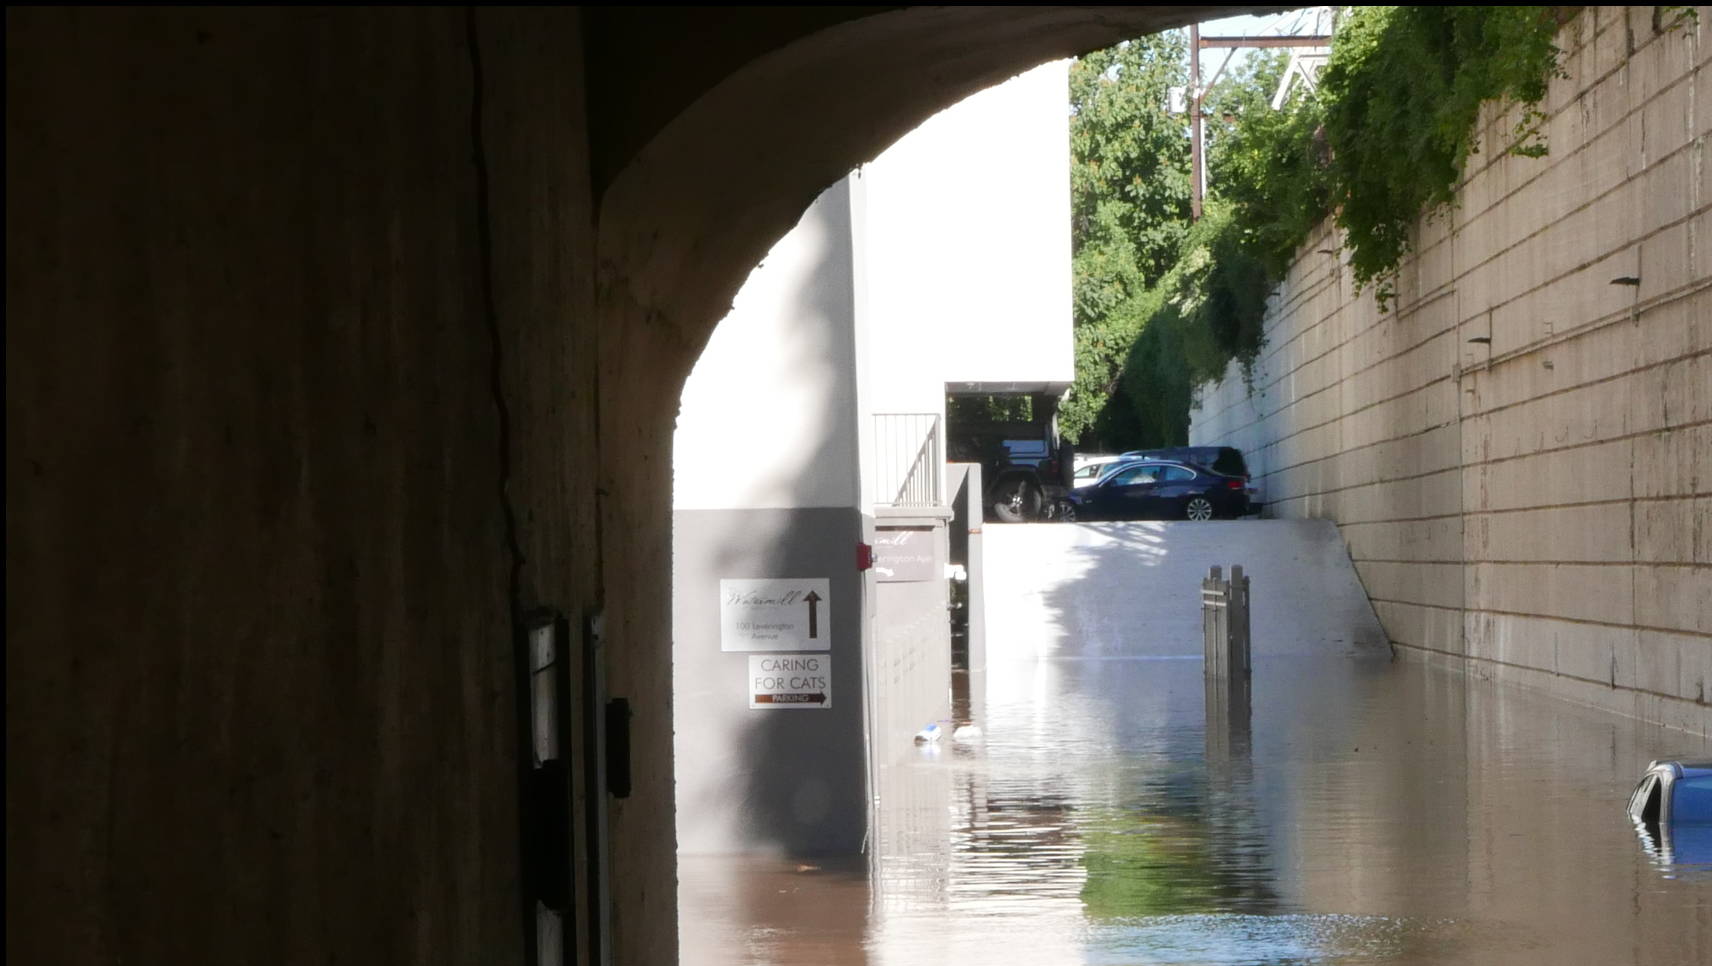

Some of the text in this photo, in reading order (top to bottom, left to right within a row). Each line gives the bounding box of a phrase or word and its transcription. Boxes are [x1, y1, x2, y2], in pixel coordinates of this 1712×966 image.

[760, 658, 820, 672] CARING
[755, 677, 828, 690] FOR CATS
[772, 694, 810, 703] PARKING
